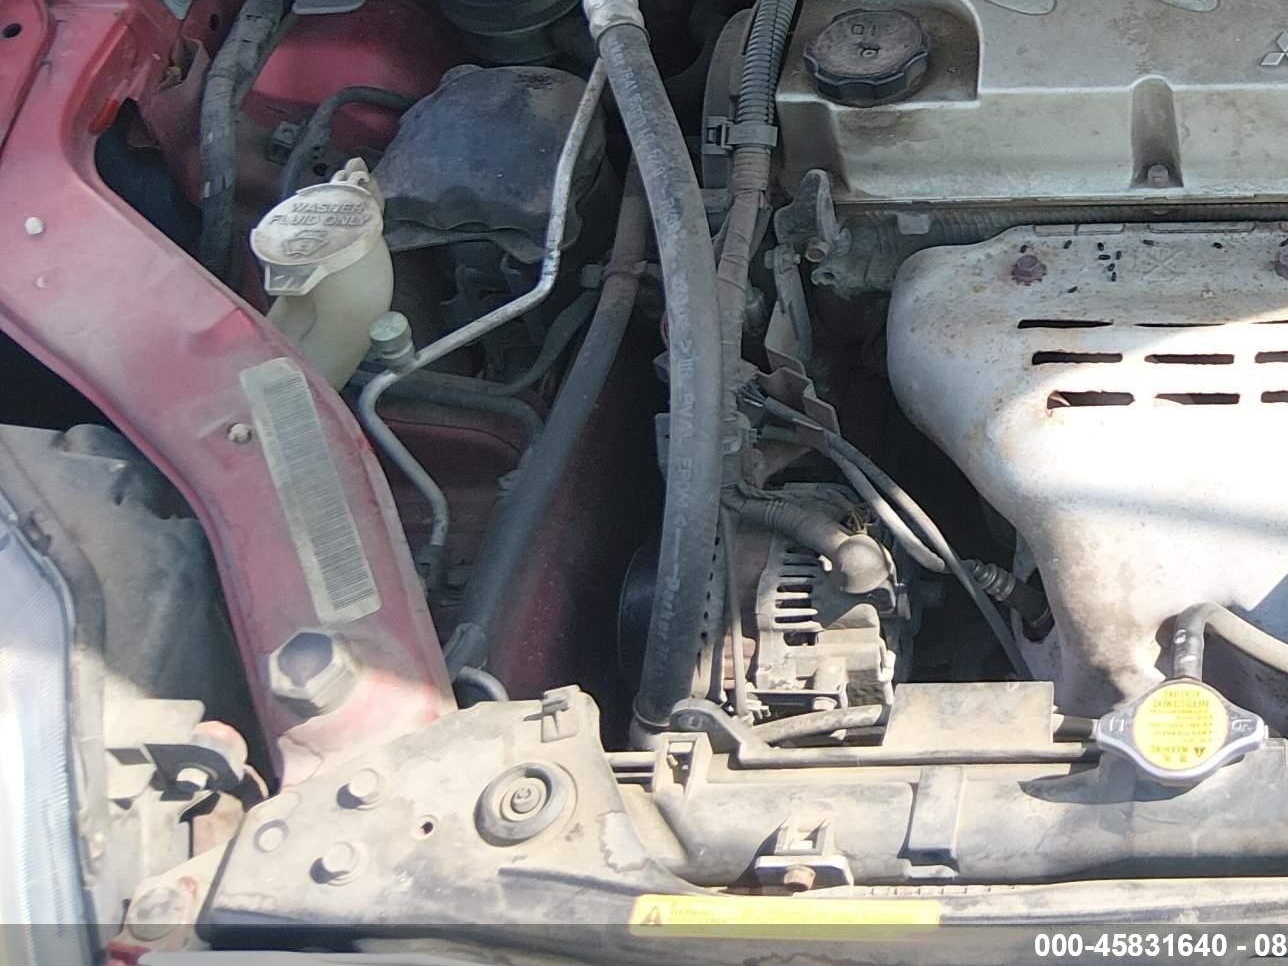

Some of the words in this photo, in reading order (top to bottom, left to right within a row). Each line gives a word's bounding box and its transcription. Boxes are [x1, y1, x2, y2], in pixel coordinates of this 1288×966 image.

[292, 202, 366, 214] WASHER
[268, 215, 320, 226] FLUID
[323, 215, 370, 227] ONLY
